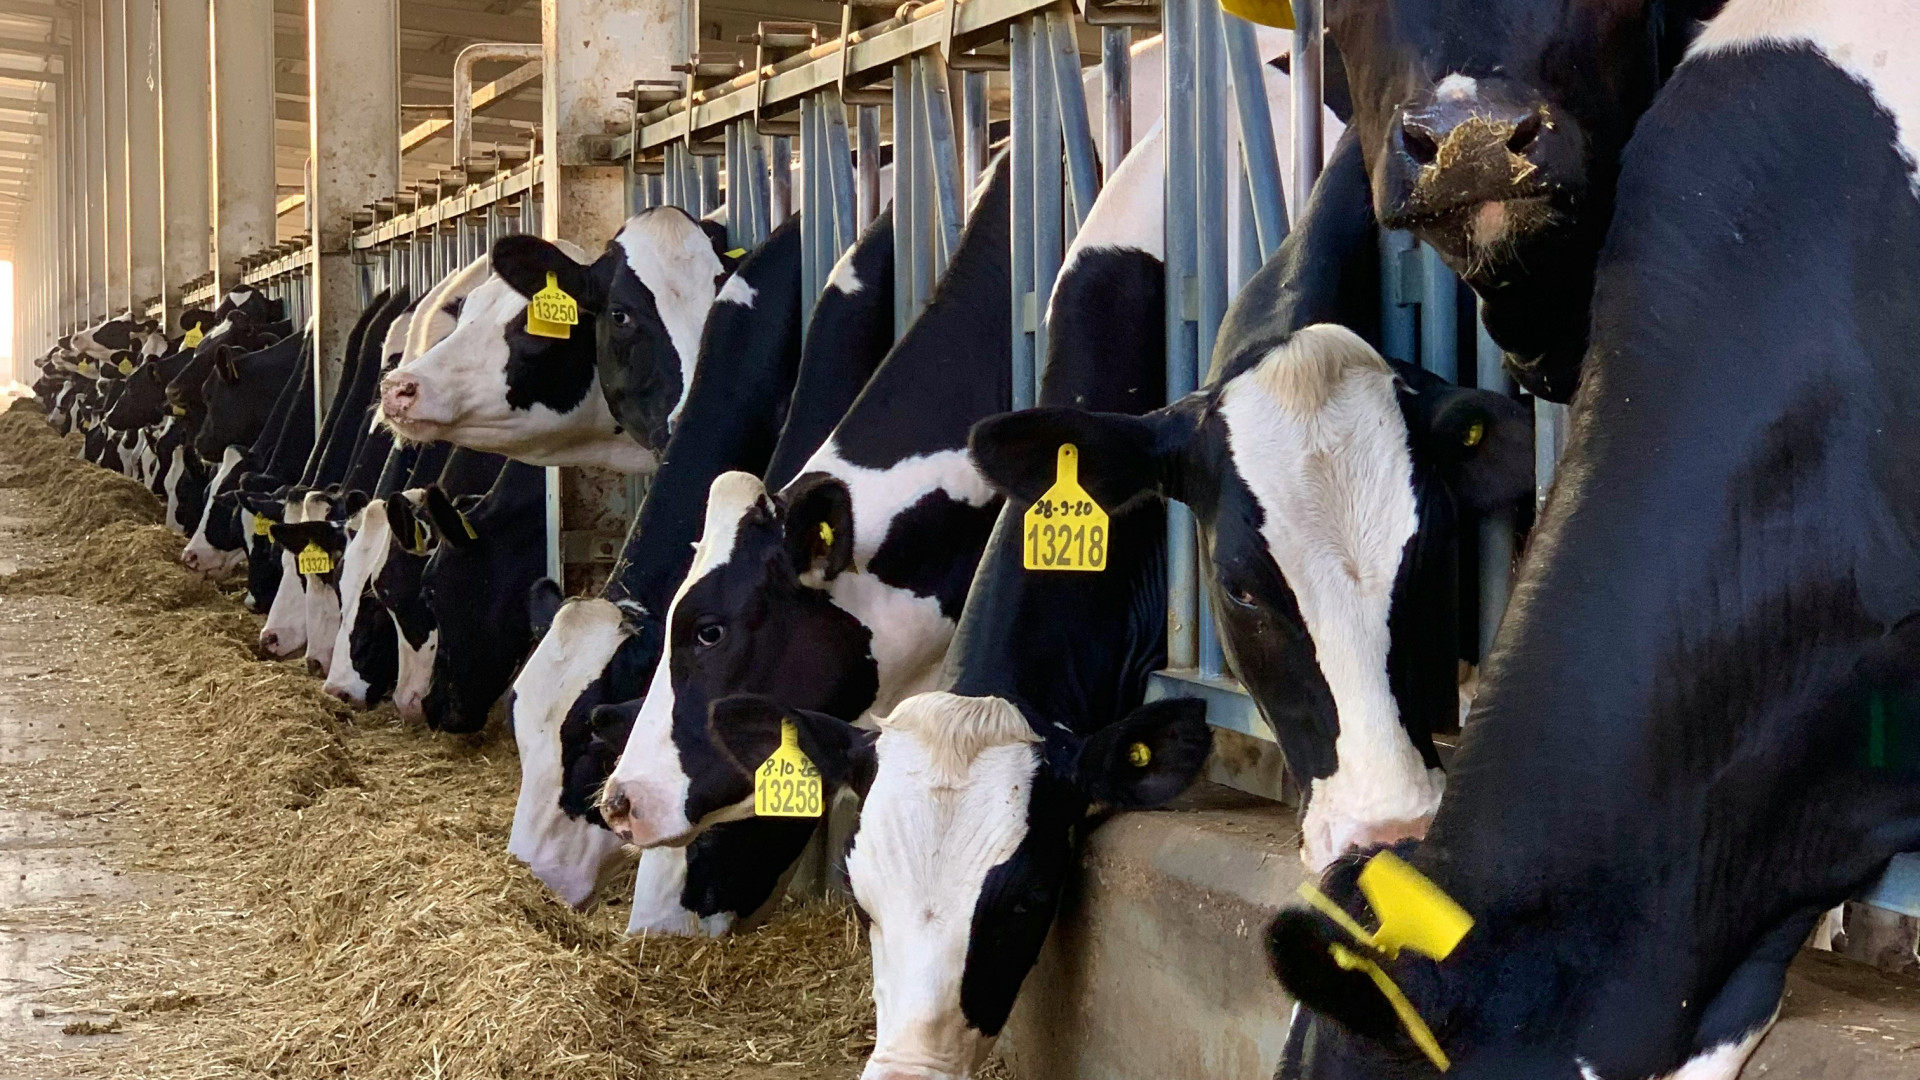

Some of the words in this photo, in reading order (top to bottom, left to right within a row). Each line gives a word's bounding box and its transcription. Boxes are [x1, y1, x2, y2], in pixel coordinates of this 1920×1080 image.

[536, 301, 576, 323] 13250
[1034, 500, 1093, 518] 28-9-20
[1028, 524, 1104, 567] 13218
[300, 557, 328, 573] 13327
[758, 779, 820, 814] 13258
